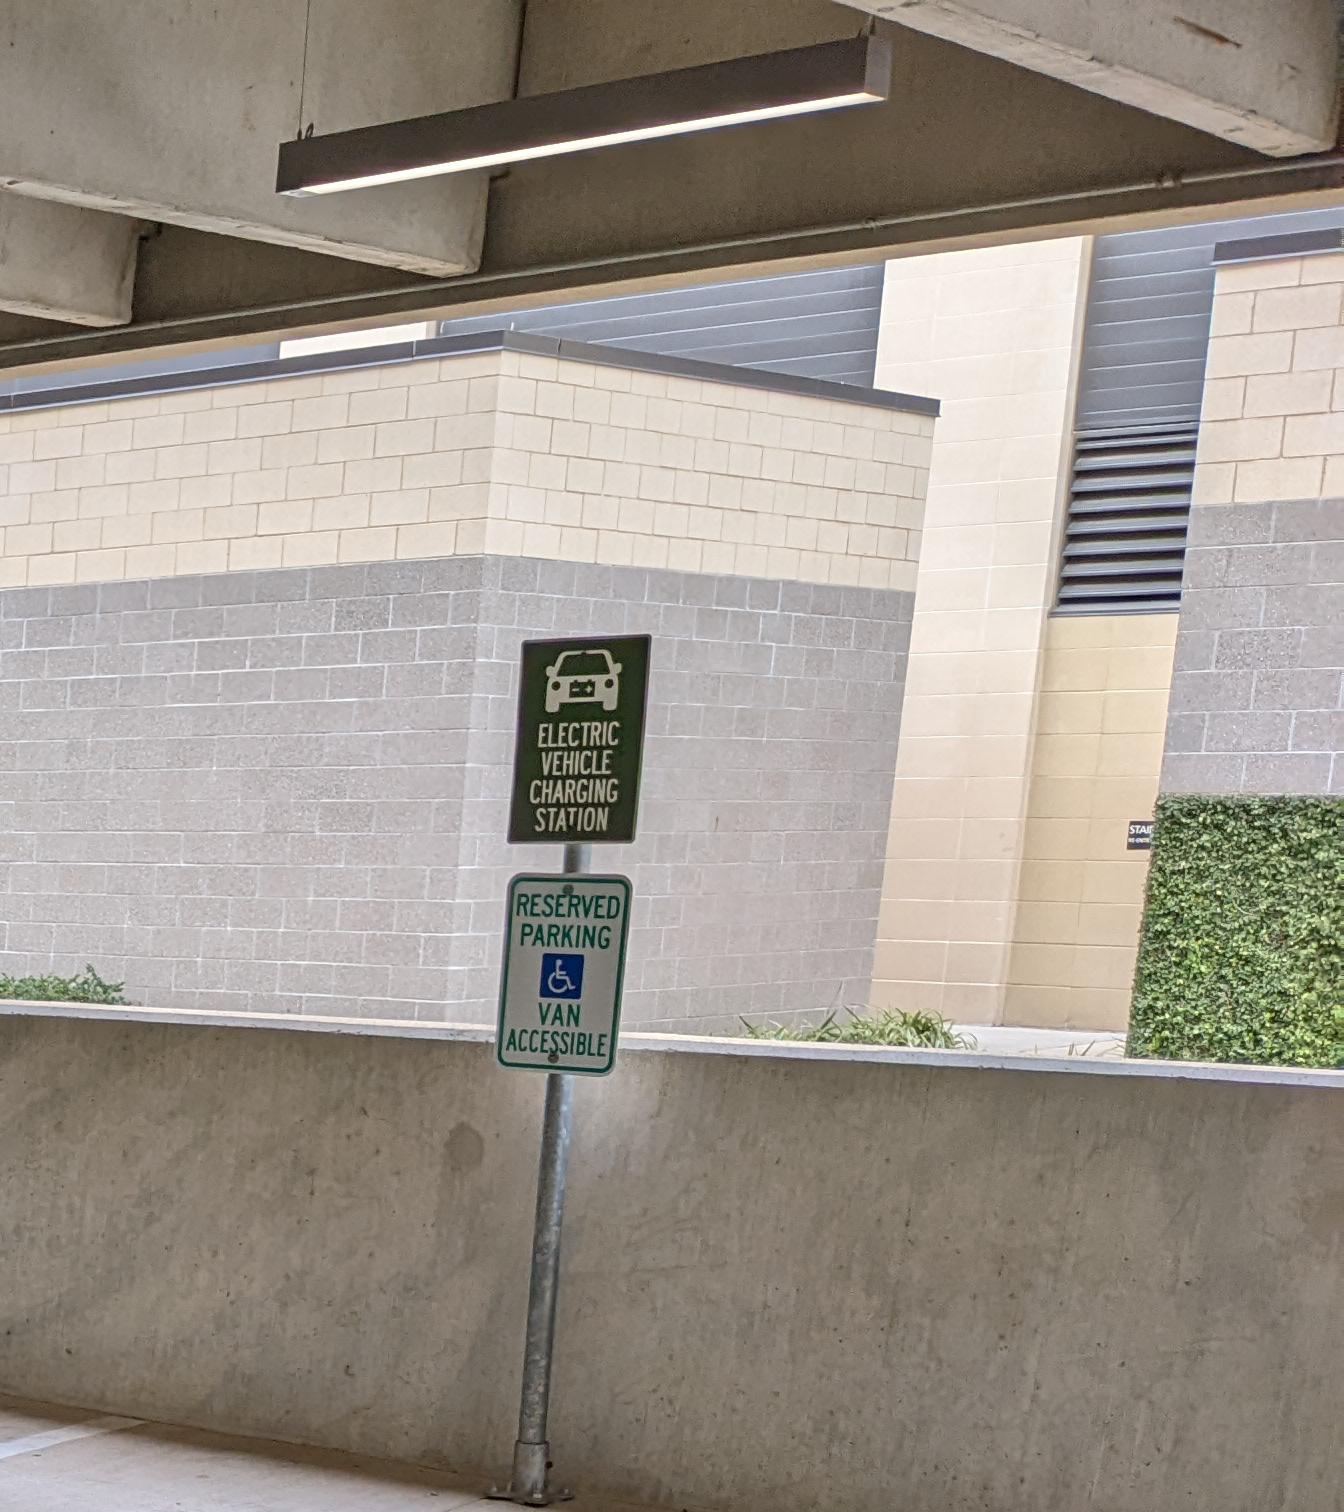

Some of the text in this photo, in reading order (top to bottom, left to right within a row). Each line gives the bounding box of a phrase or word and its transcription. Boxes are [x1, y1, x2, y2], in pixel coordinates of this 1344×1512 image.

[537, 721, 621, 748] ELECTRIC
[541, 750, 614, 776] VEHICLE
[529, 778, 619, 804] CHARGING
[534, 806, 609, 832] STATION
[516, 893, 621, 920] RESERVED
[520, 923, 612, 950] PARKING
[538, 1002, 581, 1027] VAN
[505, 1028, 608, 1057] ACCESSIBLE
